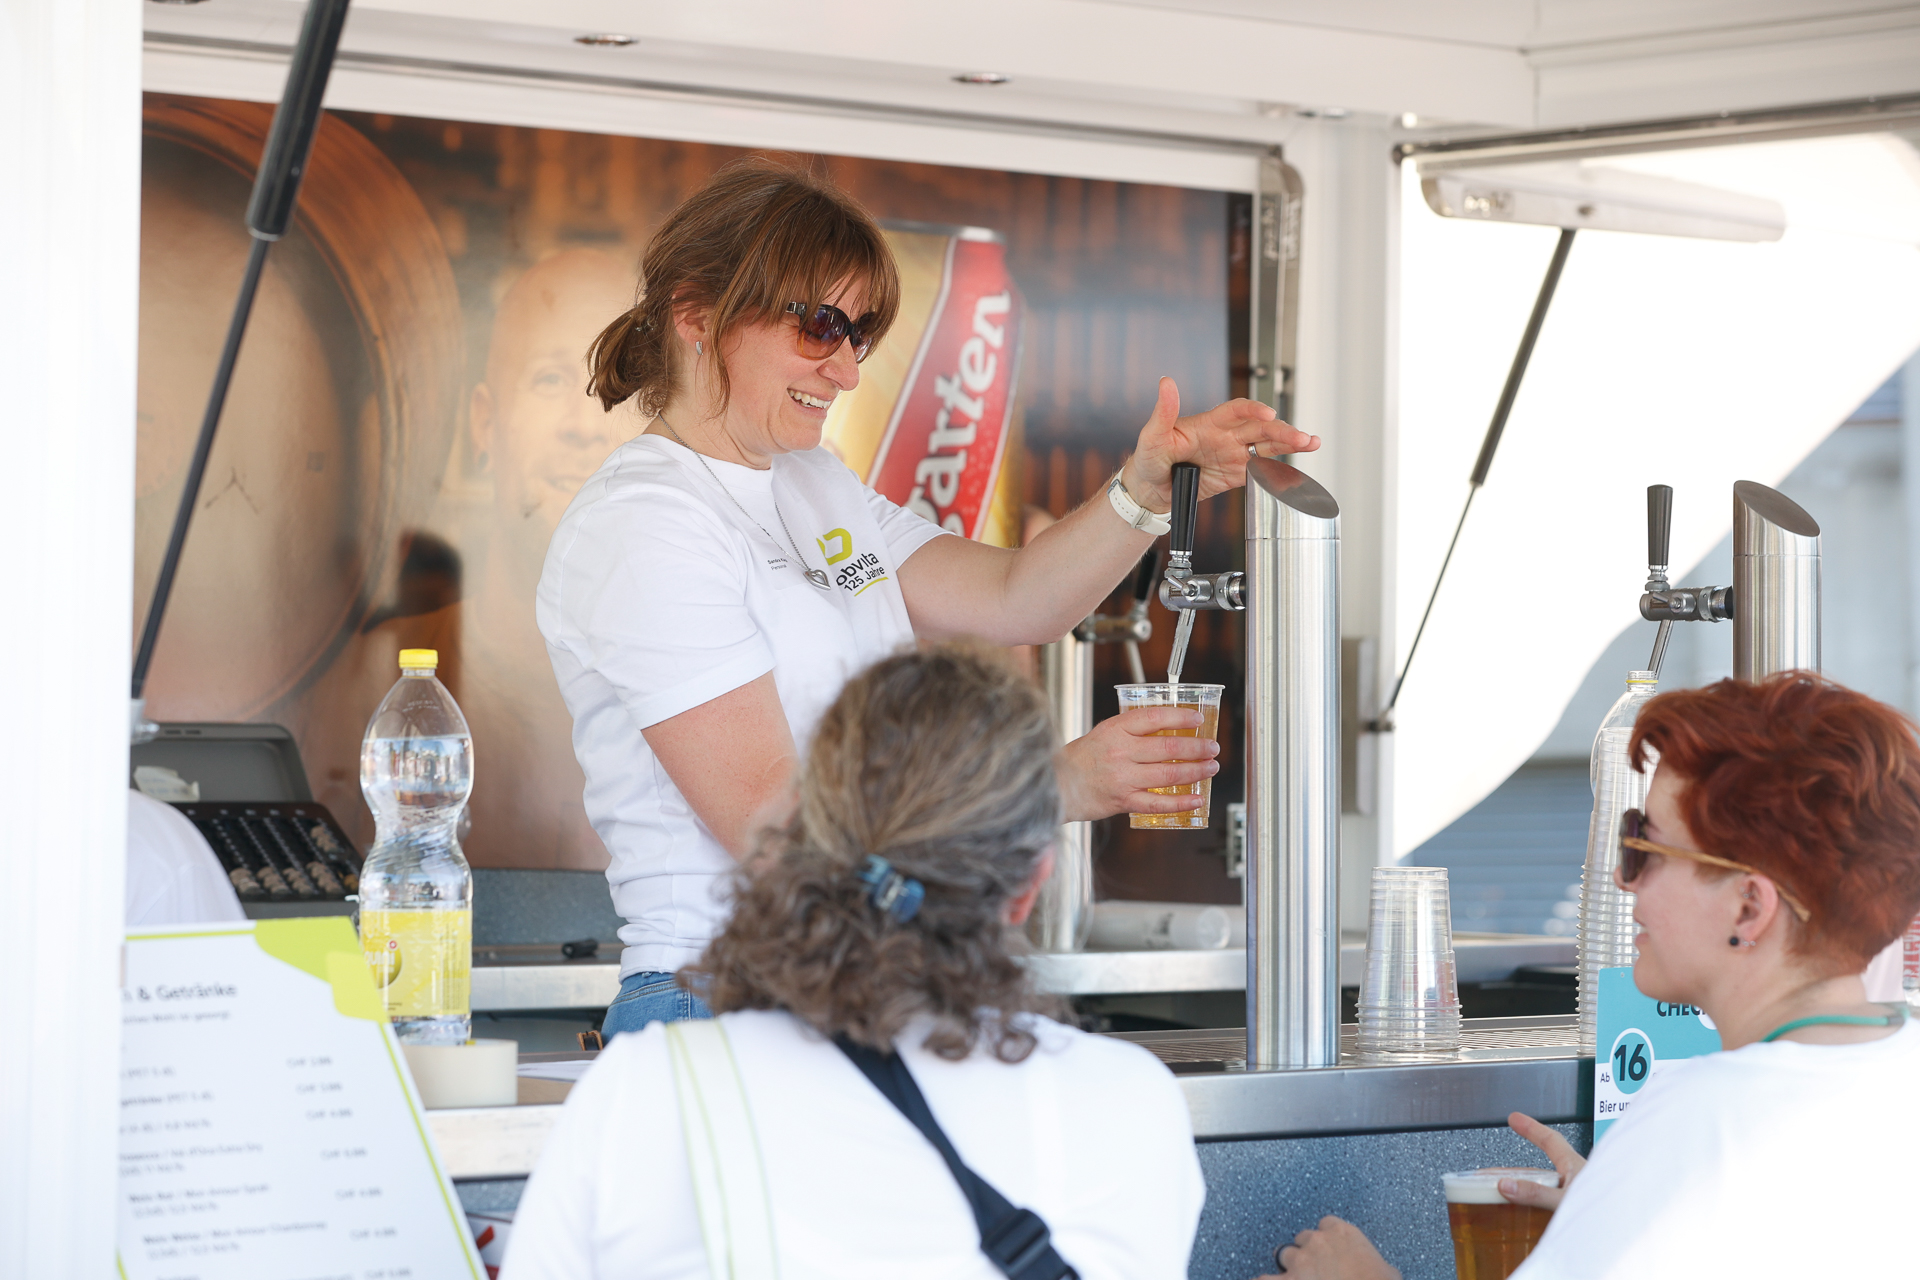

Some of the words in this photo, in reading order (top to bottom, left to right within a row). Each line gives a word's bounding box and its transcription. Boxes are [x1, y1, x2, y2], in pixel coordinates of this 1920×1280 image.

[836, 553, 880, 587] obvita
[844, 576, 864, 592] 125
[866, 565, 886, 580] Jahre
[156, 983, 238, 1001] Getränke
[1656, 1001, 1706, 1017] CHEC
[1600, 1072, 1610, 1083] Ab
[1614, 1043, 1648, 1082] 16
[1600, 1100, 1617, 1113] Bier
